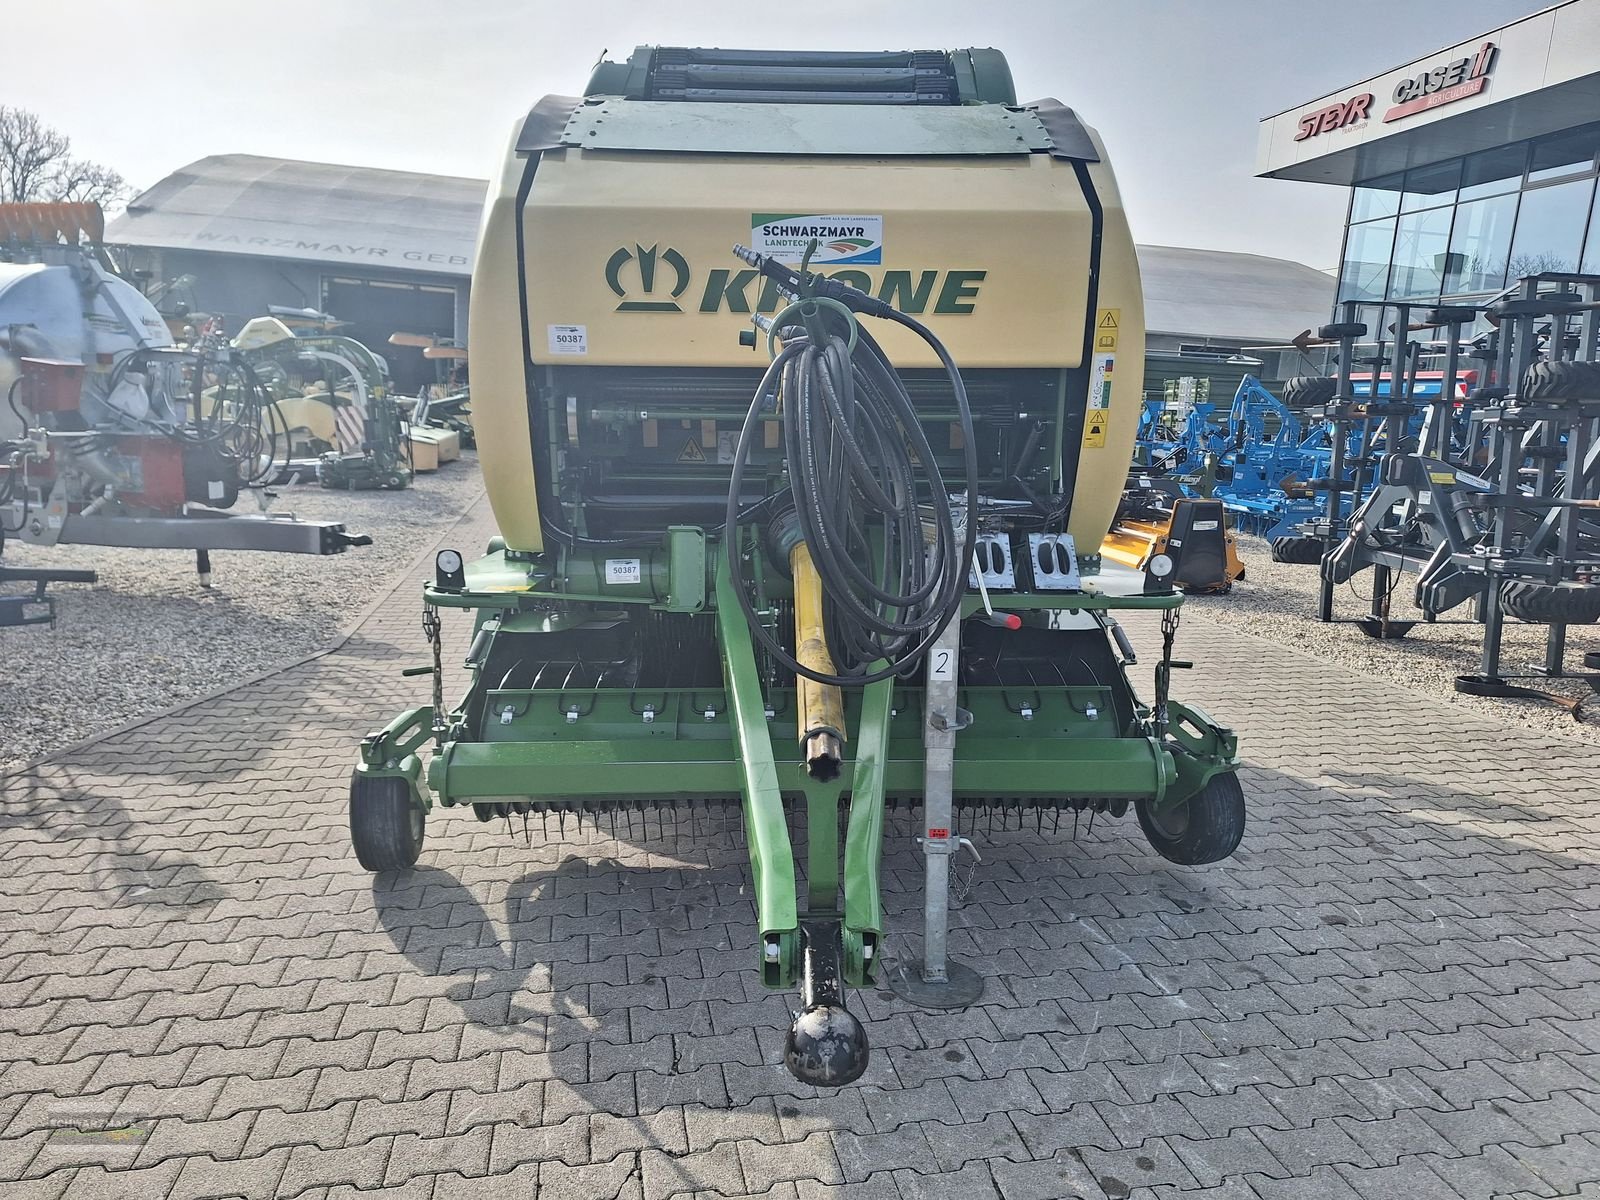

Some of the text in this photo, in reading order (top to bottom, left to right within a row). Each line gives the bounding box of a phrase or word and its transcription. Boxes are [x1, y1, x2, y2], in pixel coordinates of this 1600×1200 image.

[1391, 58, 1467, 103] CASE
[1427, 81, 1481, 106] AGRICULTURE
[1294, 94, 1373, 141] STEYR
[763, 226, 864, 237] SCHWARZMAYR
[765, 239, 824, 247] LANDTECHK
[699, 269, 987, 314] KNE
[556, 335, 583, 343] 50387
[613, 566, 637, 574] 50387
[935, 652, 949, 673] 2
